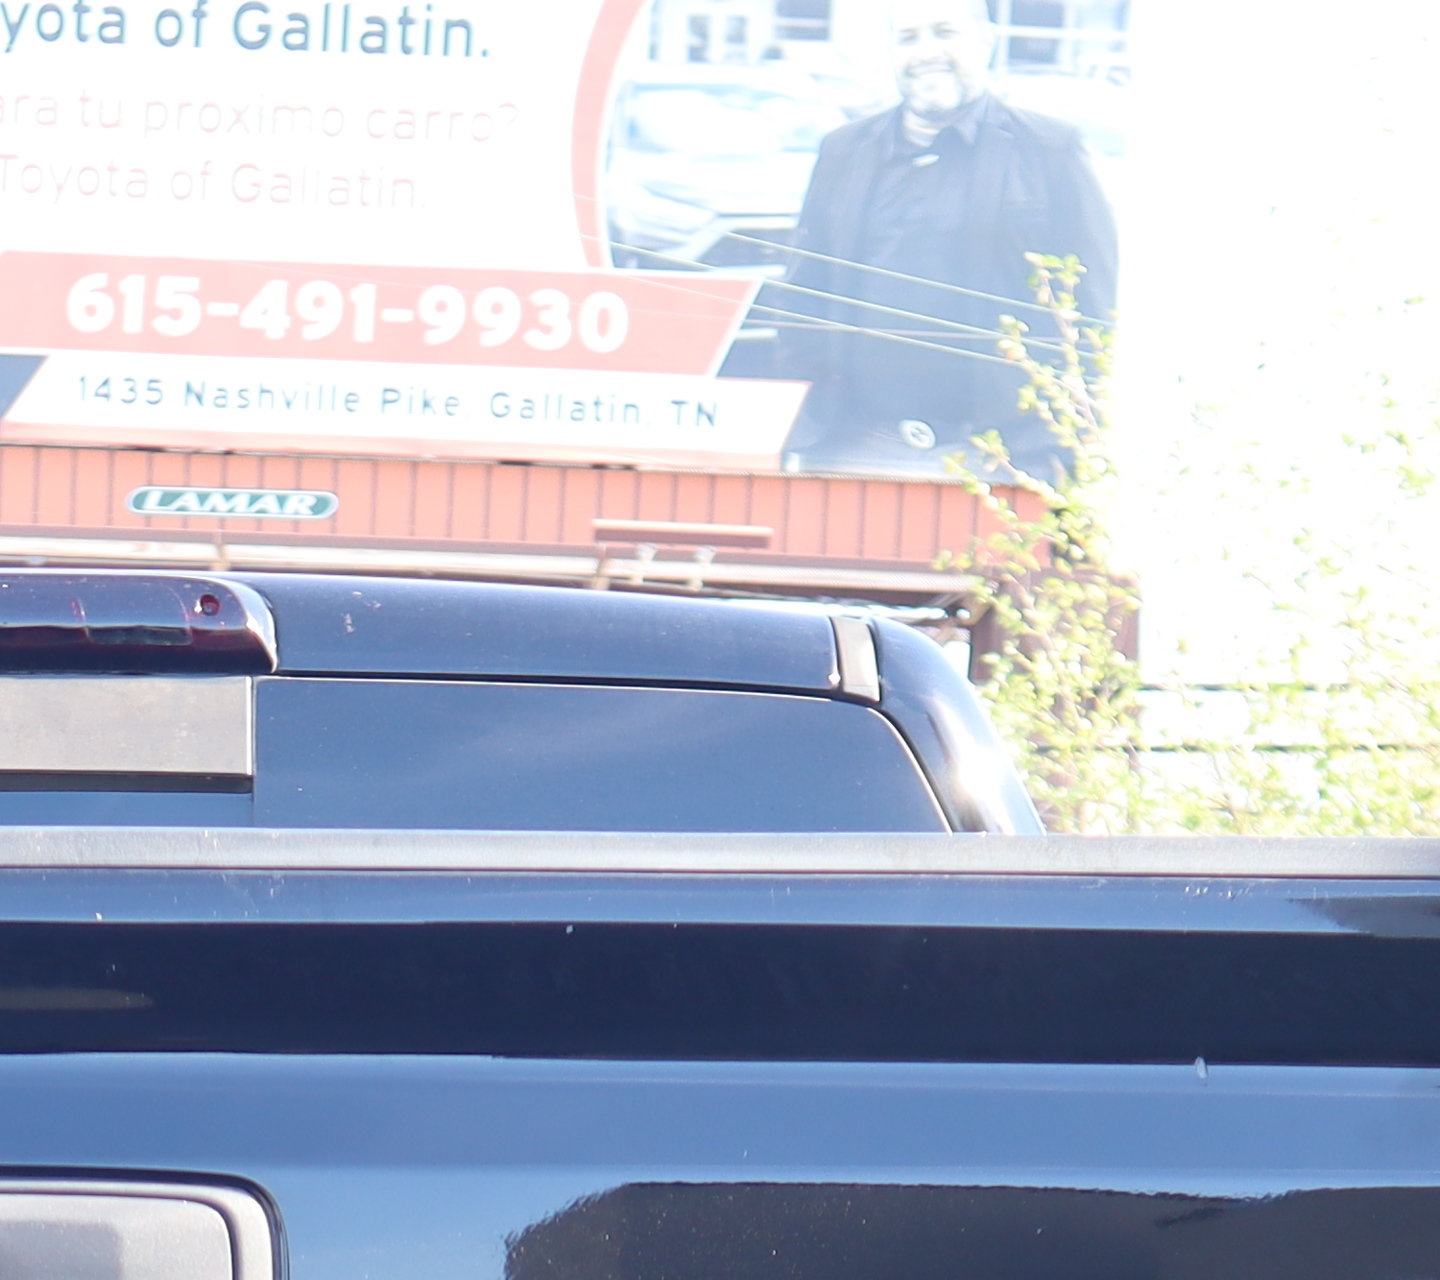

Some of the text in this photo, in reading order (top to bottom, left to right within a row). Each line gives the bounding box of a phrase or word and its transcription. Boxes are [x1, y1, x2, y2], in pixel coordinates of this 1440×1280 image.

[153, 0, 210, 48] of
[231, 0, 491, 58] Gallatin.
[78, 88, 125, 129] tu
[366, 101, 520, 144] carro?
[170, 159, 214, 202] of
[65, 272, 631, 355] 615-491-9930
[77, 374, 166, 406] 1435
[182, 379, 362, 414] Nashville
[670, 399, 720, 429] TN
[142, 489, 319, 516] LAMAR
